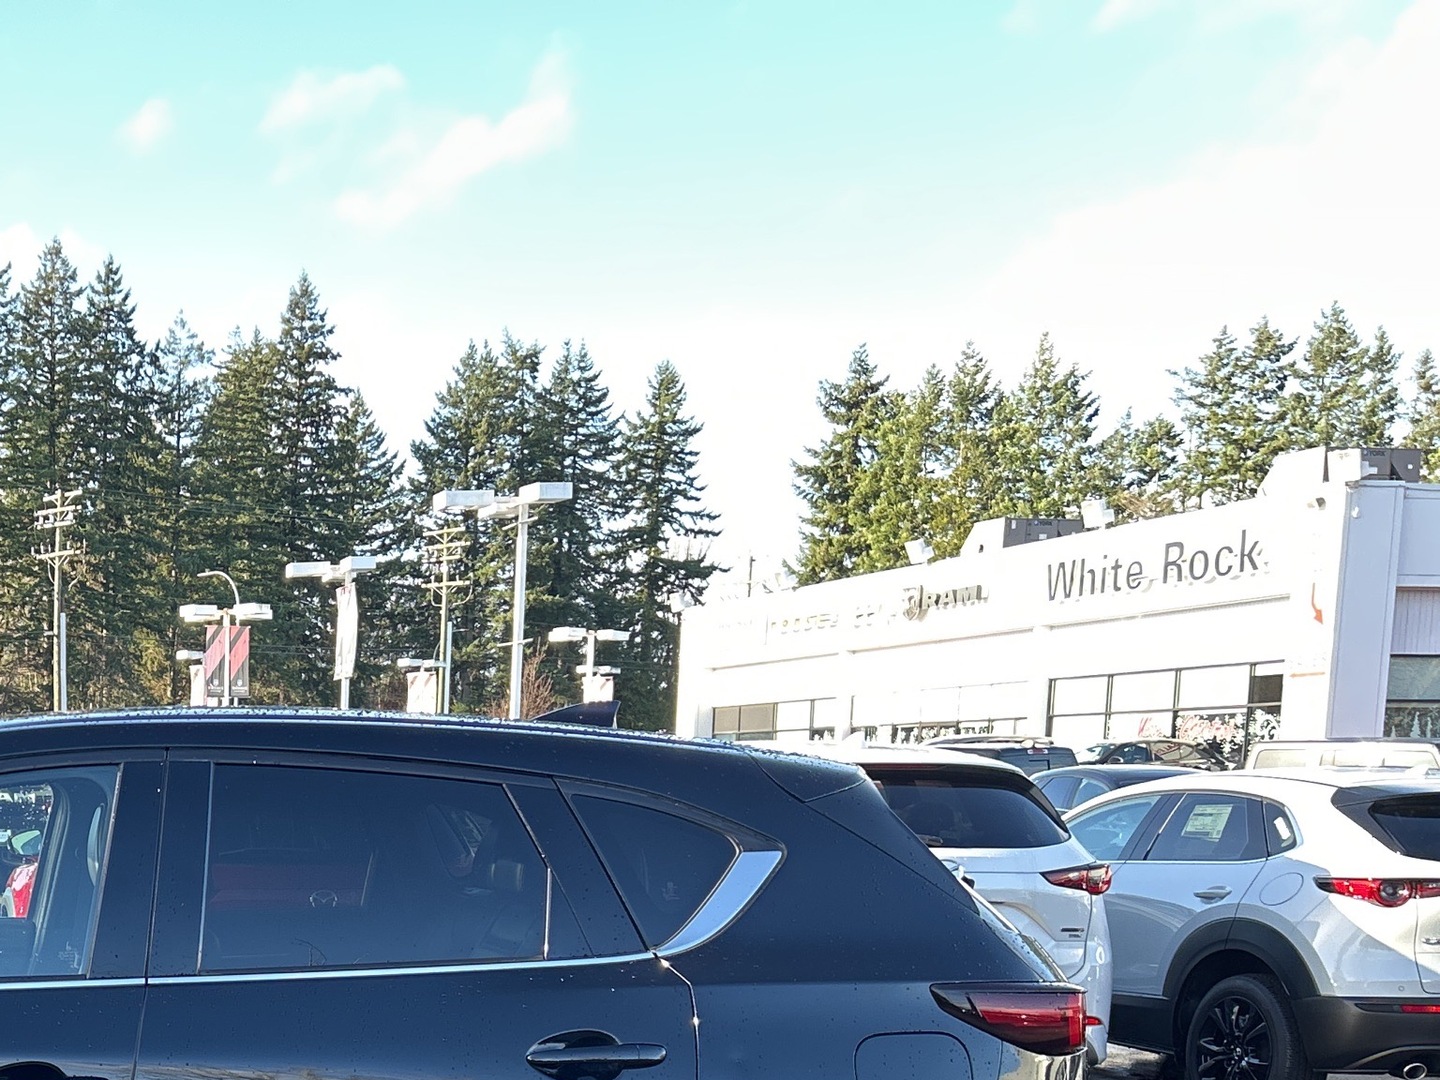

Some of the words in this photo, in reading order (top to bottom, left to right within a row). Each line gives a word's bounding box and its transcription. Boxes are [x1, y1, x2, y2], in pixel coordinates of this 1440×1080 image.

[1047, 554, 1143, 601] White
[1162, 529, 1260, 584] Rock
[921, 585, 984, 609] RAM
